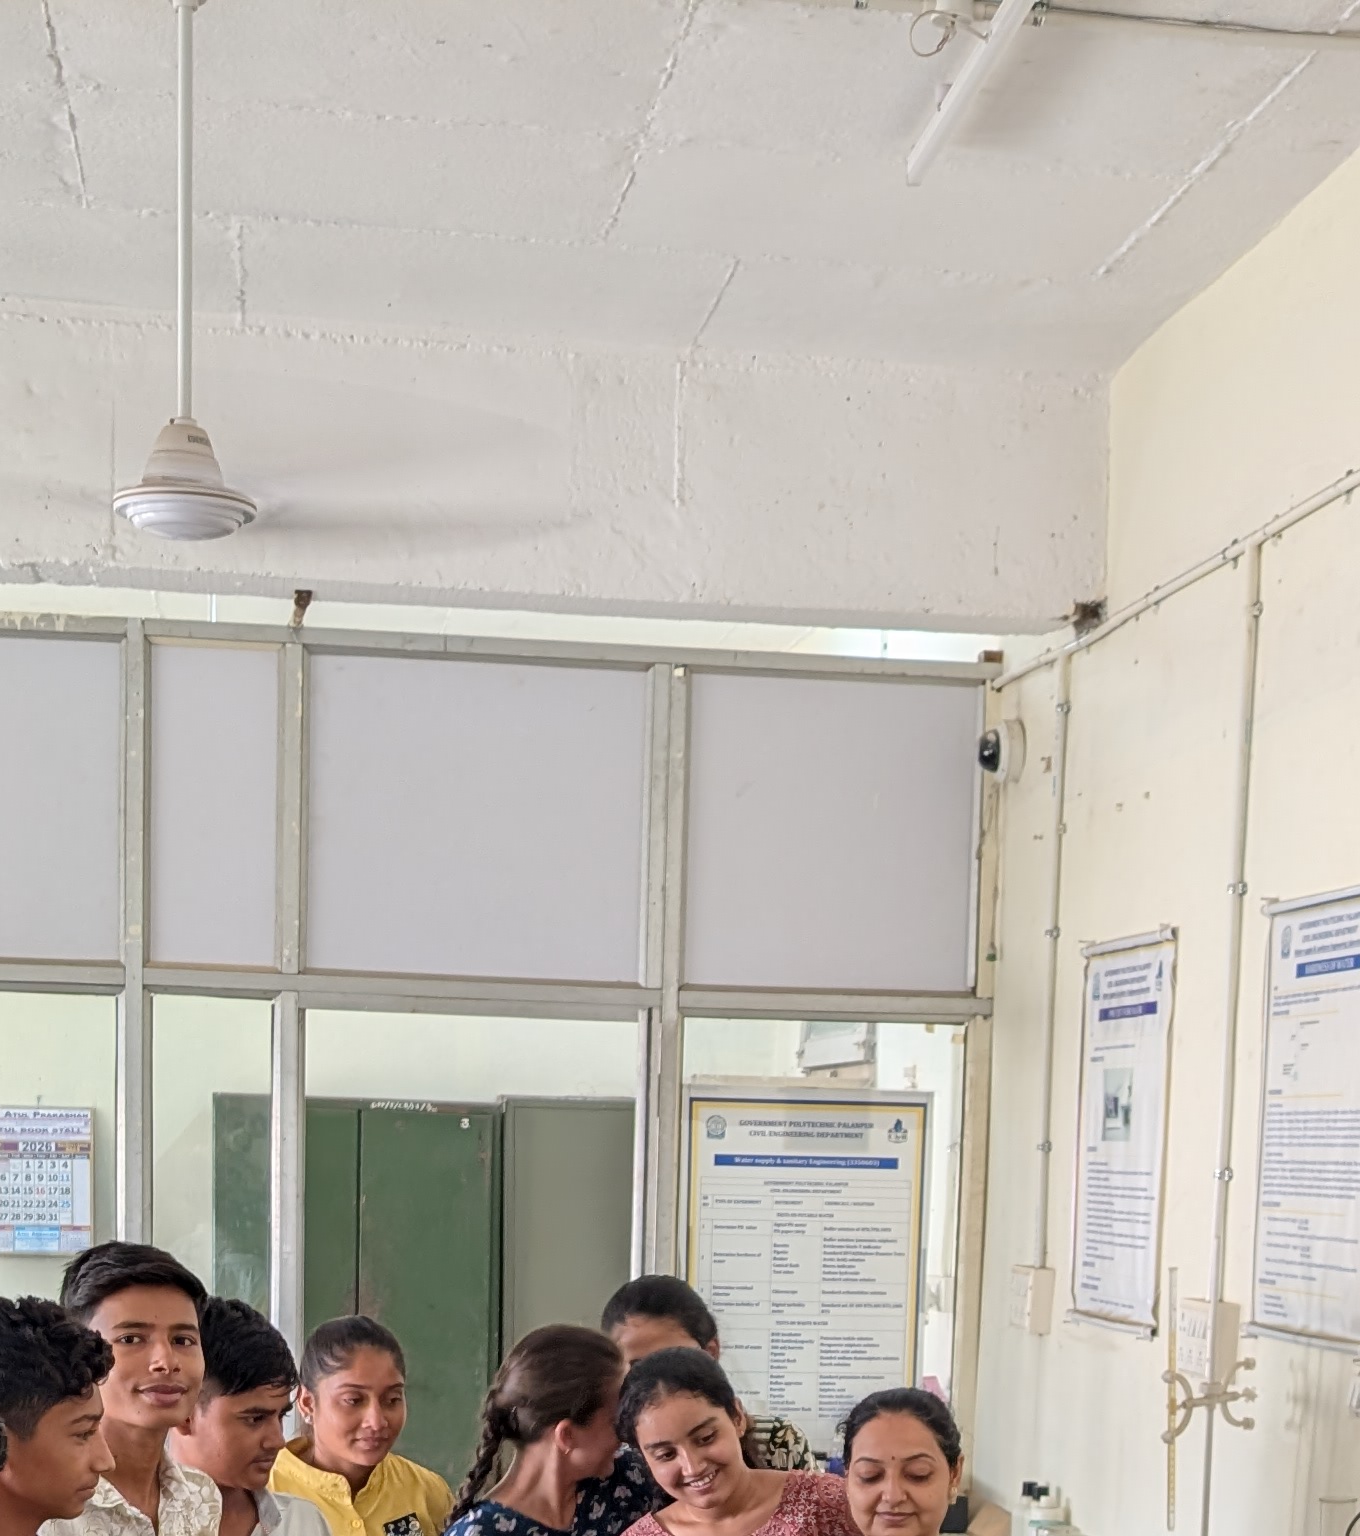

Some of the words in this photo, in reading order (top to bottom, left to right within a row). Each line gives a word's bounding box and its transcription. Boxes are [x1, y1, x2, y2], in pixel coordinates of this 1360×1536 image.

[22, 1142, 52, 1152] 2026
[25, 1161, 30, 1169] 1
[37, 1161, 44, 1169] 2
[50, 1161, 56, 1169] 3
[61, 1161, 68, 1169] 4
[0, 1174, 6, 1182] 6
[12, 1174, 19, 1182] 7
[25, 1174, 31, 1182] 8
[37, 1174, 44, 1182] 9
[48, 1174, 58, 1182] 10
[11, 1187, 21, 1195] 14
[23, 1187, 33, 1195] 15
[48, 1187, 58, 1195] 17
[60, 1187, 71, 1195] 18
[11, 1200, 20, 1208] 21
[23, 1200, 33, 1208] 22
[35, 1200, 46, 1208] 23
[48, 1200, 58, 1208] 24
[11, 1213, 21, 1221] 28
[23, 1213, 33, 1221] 29
[35, 1213, 46, 1221] 30
[48, 1213, 58, 1221] 31
